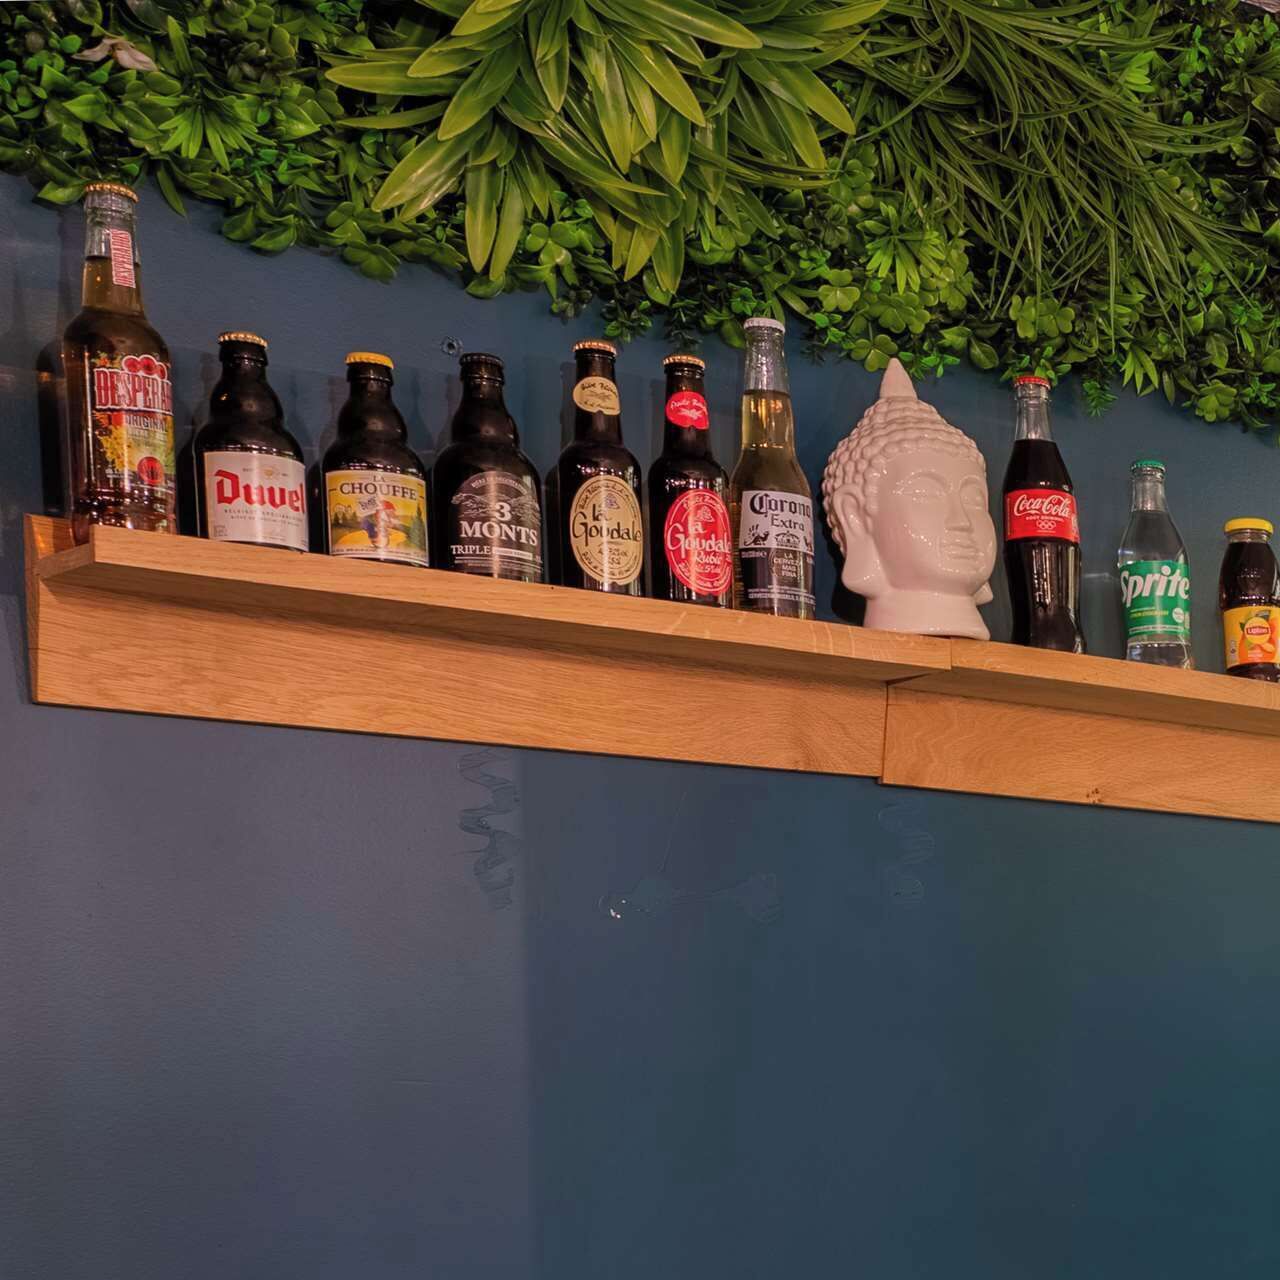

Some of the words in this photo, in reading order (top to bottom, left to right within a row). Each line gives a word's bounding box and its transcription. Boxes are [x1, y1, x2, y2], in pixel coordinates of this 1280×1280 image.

[126, 416, 167, 433] ORIGINAL
[372, 475, 386, 483] LA
[214, 469, 306, 513] Duvel
[339, 482, 417, 501] CHOUFFE
[494, 502, 512, 521] 3
[1014, 494, 1070, 518] Coca-Cola
[572, 511, 642, 547] Goudale
[770, 514, 805, 532] Extra
[459, 520, 538, 546] MONTS
[451, 545, 492, 555] TRIPLE
[773, 558, 800, 566] CERVEZ
[1121, 565, 1190, 608] Sprite
